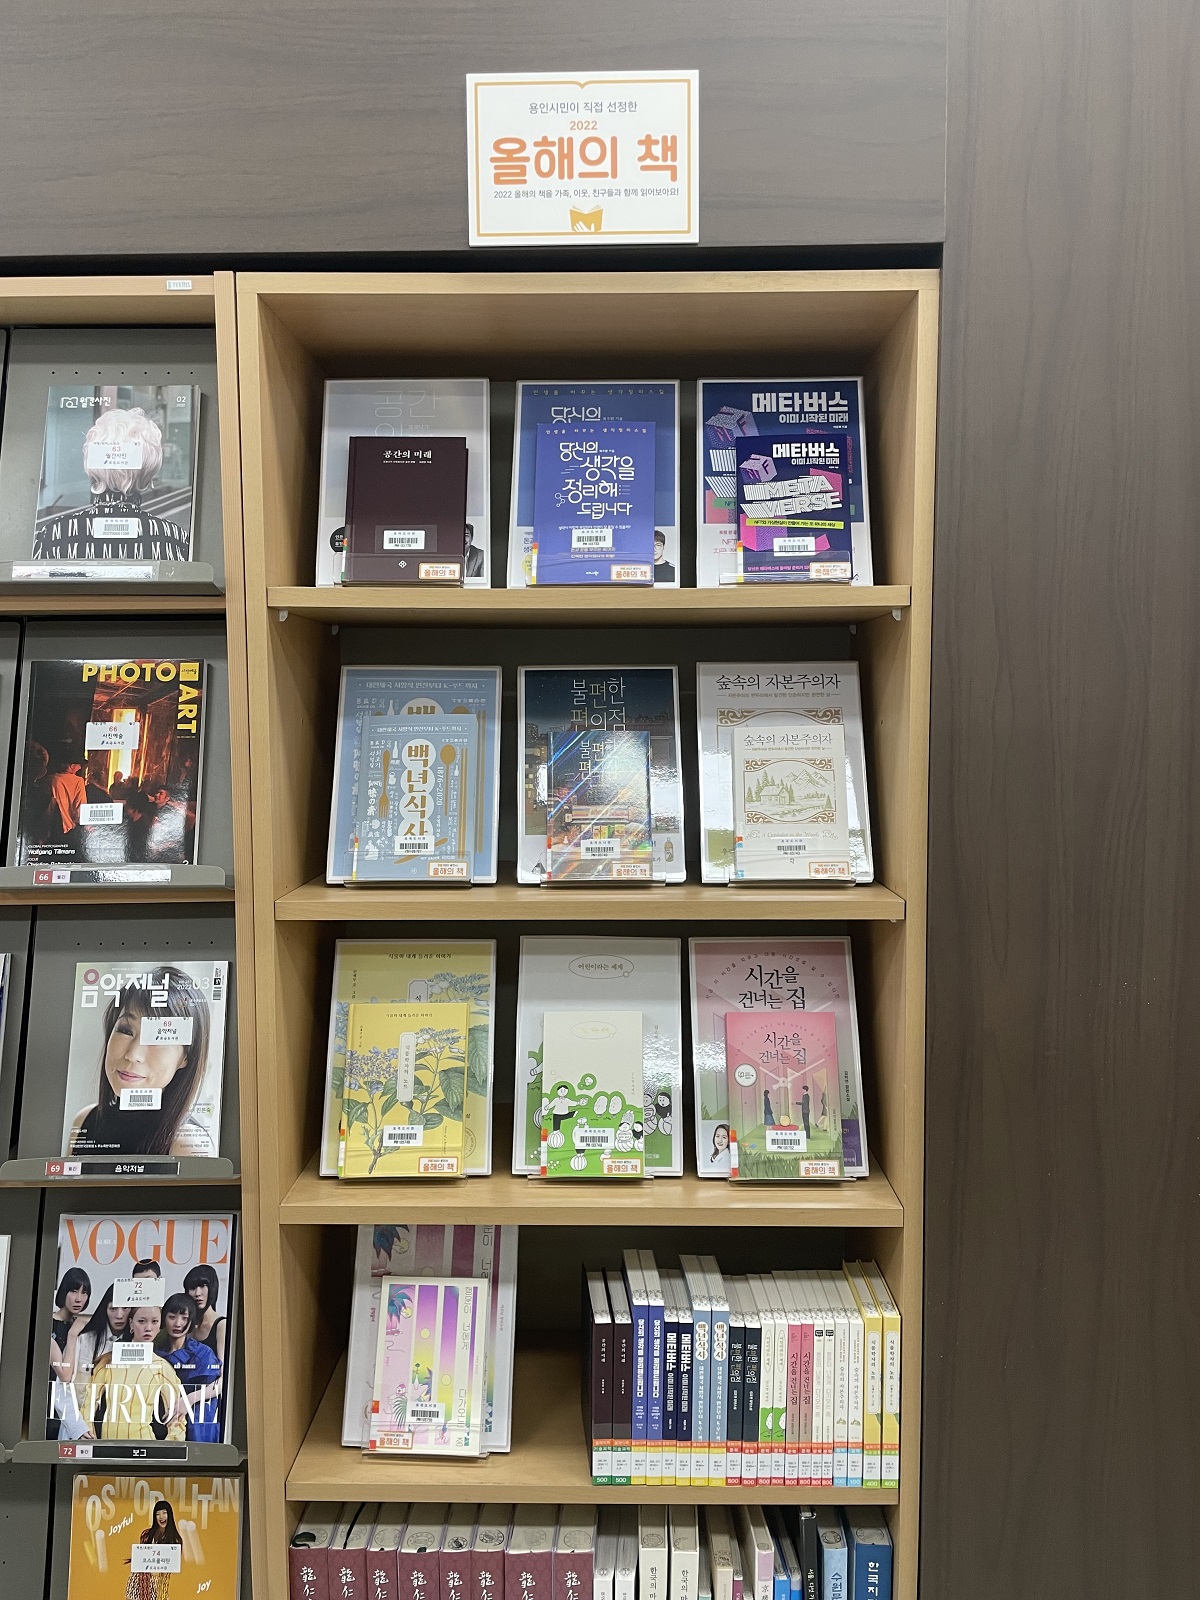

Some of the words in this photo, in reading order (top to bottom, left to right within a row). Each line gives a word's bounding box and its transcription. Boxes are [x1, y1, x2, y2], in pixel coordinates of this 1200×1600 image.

[529, 102, 579, 114] 용인시민이
[583, 102, 602, 113] 직접
[607, 101, 637, 112] 선정한
[569, 121, 598, 131] 2022
[490, 136, 618, 185] 올해의
[637, 134, 677, 182] 책
[494, 191, 512, 199] 2022
[514, 190, 535, 198] 올해의
[538, 190, 552, 198] 책을
[555, 190, 572, 198] 가족,
[593, 189, 621, 197] 친구들과
[624, 189, 638, 197] 함께
[641, 189, 679, 197] 읽어보아요!
[80, 396, 111, 408] 월간사진
[752, 392, 849, 413] 메타버스
[551, 407, 601, 423] 당신의
[779, 414, 799, 423] 이미
[801, 413, 828, 423] 시작된
[829, 413, 848, 422] 미래
[383, 450, 410, 459] 공간의
[414, 450, 432, 459] 미래
[559, 442, 598, 461] 당신의
[773, 443, 840, 458] 메타버스
[580, 456, 635, 481] 생각을
[562, 479, 618, 503] 정리해
[577, 503, 632, 519] 드립니다
[449, 569, 456, 577] 책
[640, 570, 647, 578] 책
[82, 663, 176, 682] PHOTO
[716, 675, 761, 690] 숲속의
[765, 674, 841, 690] 자본주의자
[571, 677, 626, 709] 불편한
[177, 684, 199, 733] ART
[744, 734, 775, 746] 숲속의
[779, 734, 833, 745] 자본주의자
[404, 744, 430, 836] 백년식사
[457, 867, 464, 875] 책
[578, 963, 609, 971] 어린이라는
[192, 978, 210, 990] 03
[744, 964, 800, 989] 시간을
[81, 969, 169, 1008] 음악저널
[738, 991, 783, 1009] 건너는
[786, 987, 806, 1010] 집
[764, 1032, 802, 1050] 시간을
[759, 1050, 790, 1064] 건너는
[792, 1048, 807, 1065] 집
[423, 1163, 445, 1171] 올해의
[447, 1163, 454, 1171] 책
[607, 1164, 628, 1173] 올해의
[631, 1164, 637, 1173] 책
[804, 1166, 825, 1175] 올해의
[828, 1166, 835, 1175] 책
[64, 1219, 229, 1265] VOGUE
[697, 1323, 707, 1359] 백년식사
[716, 1323, 725, 1359] 백년식사
[666, 1332, 676, 1371] 메타버스
[681, 1333, 691, 1372] 메타버스
[790, 1352, 798, 1374] 시간을
[803, 1352, 811, 1374] 시간을
[47, 1381, 221, 1425] EVERYONE
[379, 1437, 400, 1446] 올해의
[402, 1438, 409, 1447] 책
[109, 1513, 133, 1537] Joyful
[196, 1580, 212, 1594] JOY
[681, 1569, 689, 1592] 한국의
